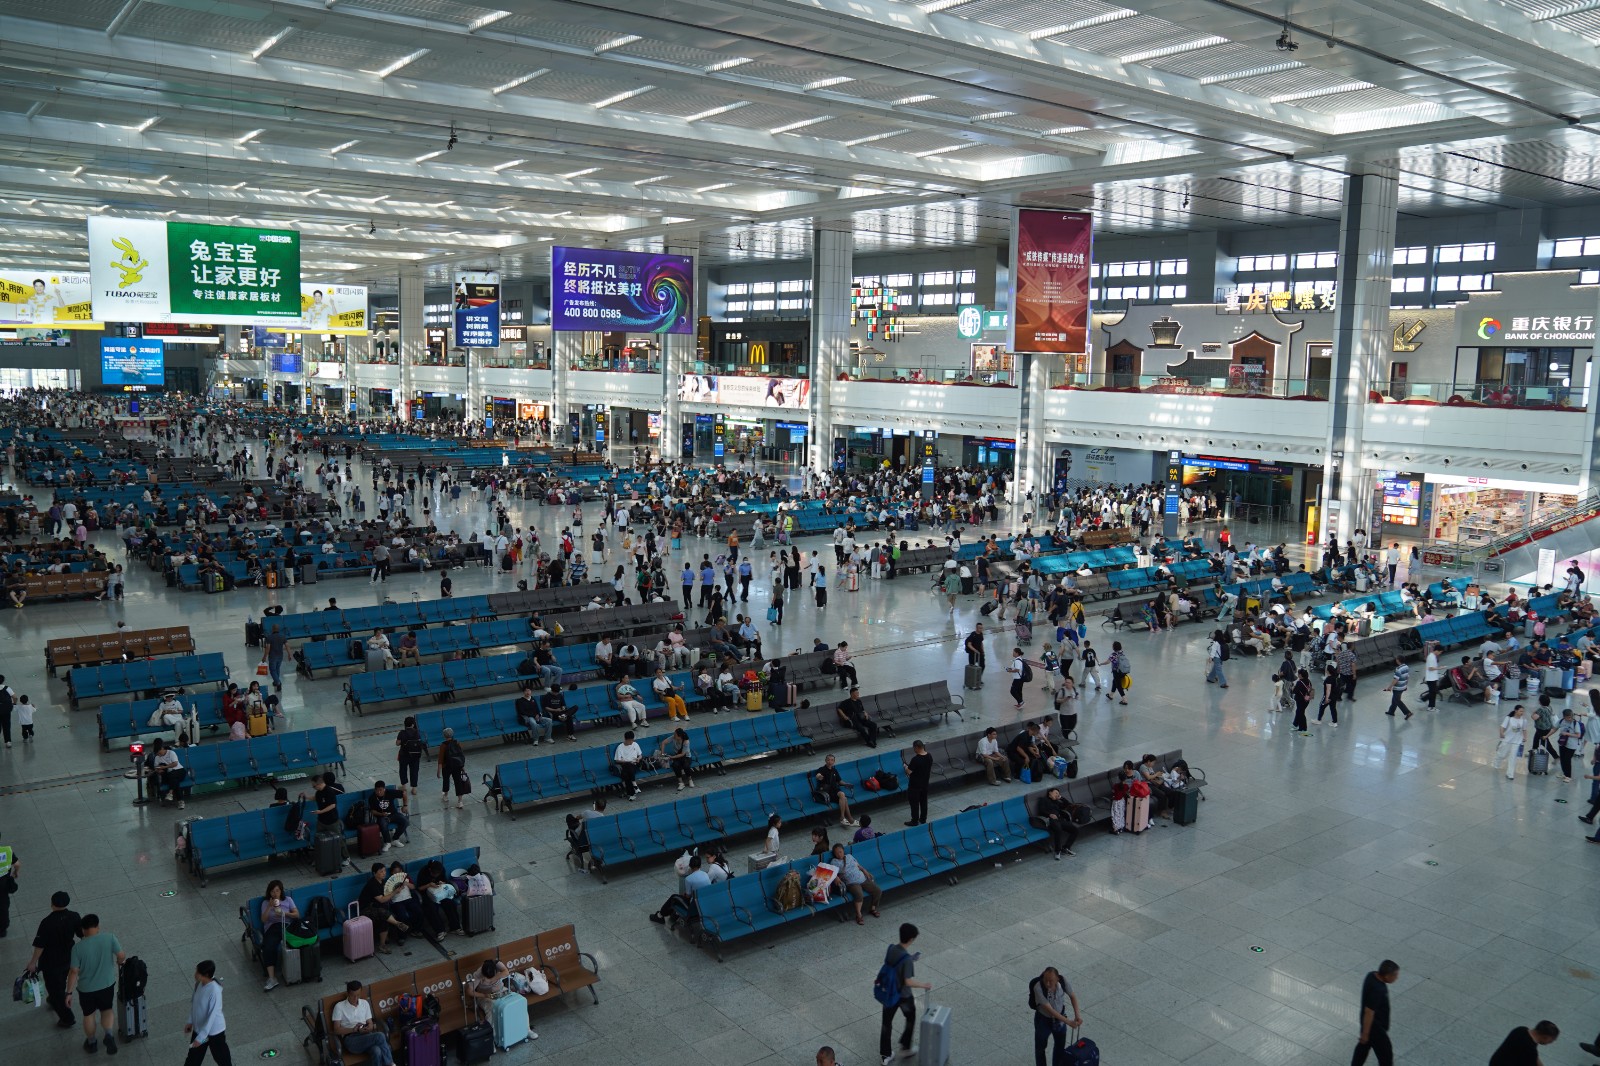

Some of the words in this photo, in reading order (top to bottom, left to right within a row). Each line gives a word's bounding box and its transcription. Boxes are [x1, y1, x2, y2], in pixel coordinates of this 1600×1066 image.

[190, 240, 257, 264] 兔宝宝
[190, 265, 282, 288] 让家更好
[563, 262, 617, 279] 经历不凡
[61, 276, 92, 285] 美团闪
[336, 288, 364, 296] 美团闪购
[563, 279, 643, 297] 终将抵达美好
[192, 289, 282, 303] 专注健康家居板材
[1224, 289, 1266, 312] 重庆
[1269, 291, 1291, 300] CHONG
[1272, 300, 1288, 309] QING
[338, 311, 364, 321] 美团闪购
[564, 307, 580, 317] 400
[582, 308, 599, 318] 800
[600, 309, 621, 319] 0585
[344, 320, 363, 328] 马上到
[1511, 316, 1593, 331] 重庆银行
[1504, 332, 1529, 340] BANK
[1530, 332, 1542, 340] OF
